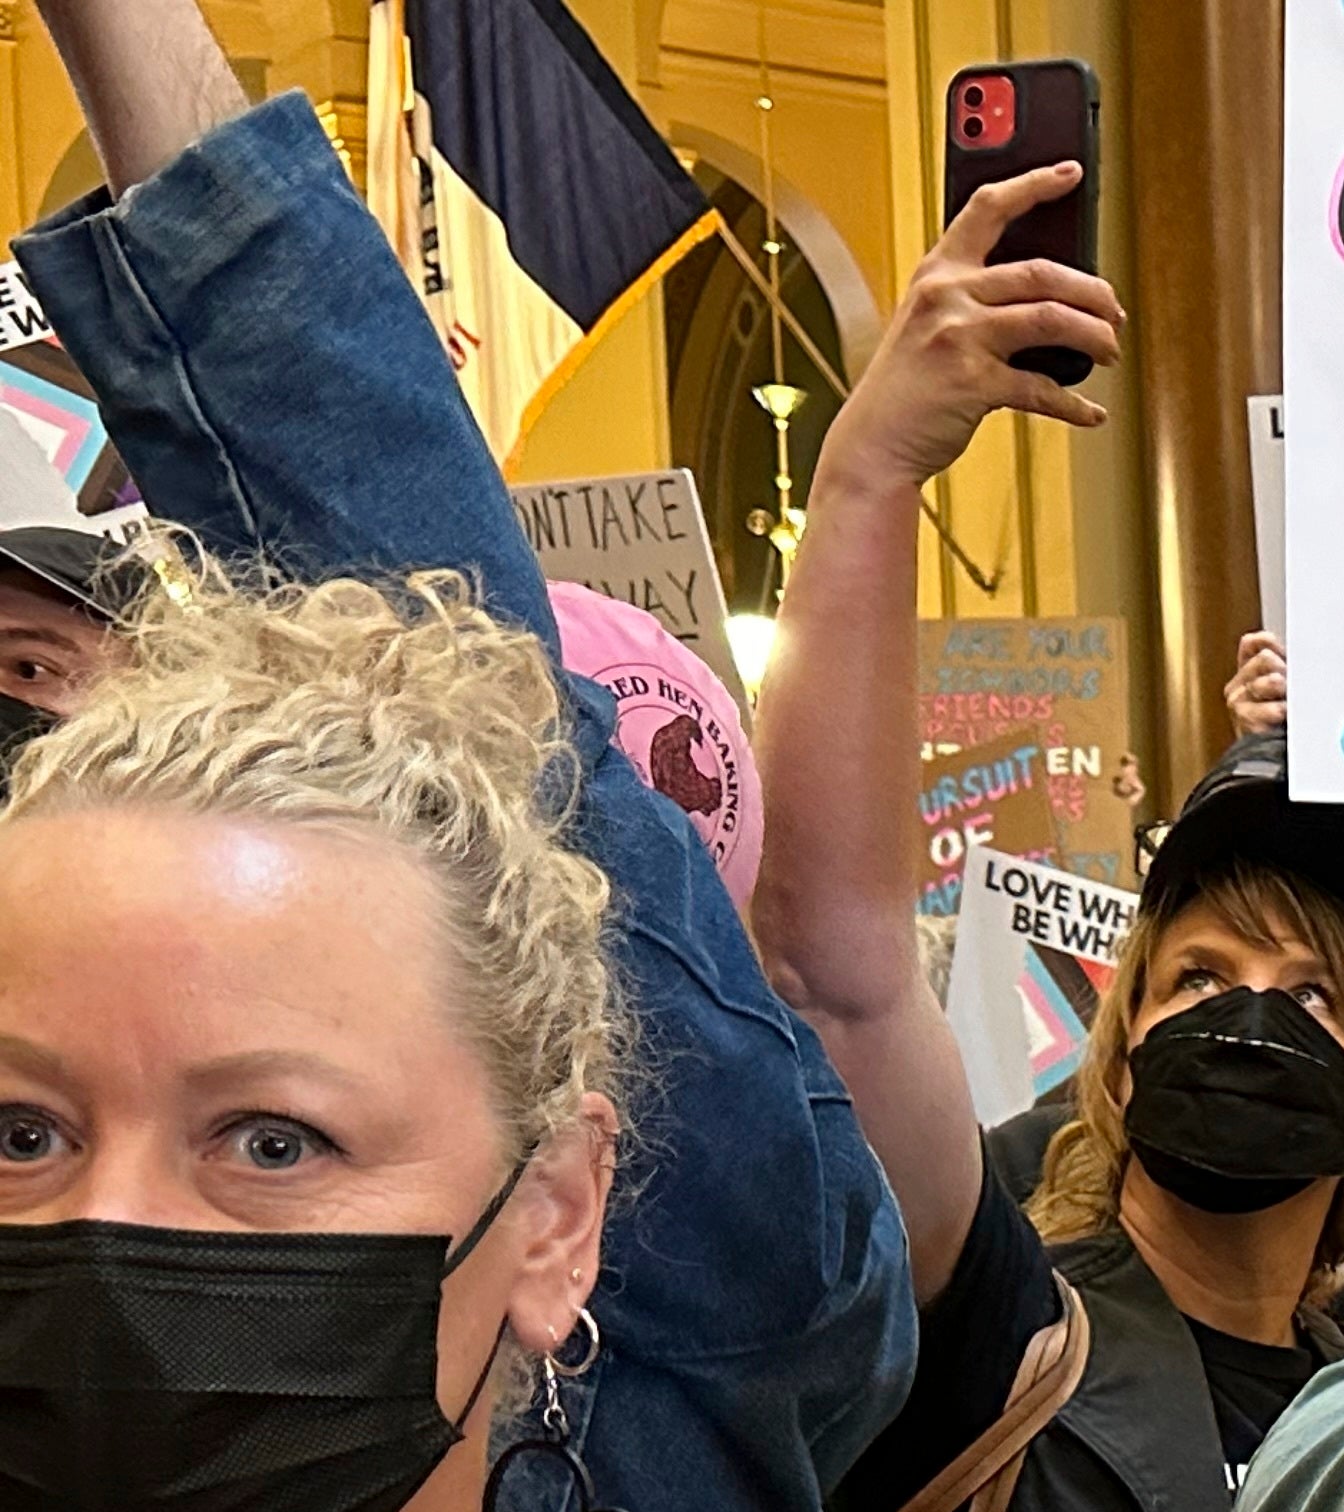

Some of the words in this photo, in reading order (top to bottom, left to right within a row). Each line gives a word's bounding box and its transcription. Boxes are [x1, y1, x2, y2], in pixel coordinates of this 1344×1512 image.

[576, 478, 686, 551] TAKE
[657, 676, 704, 721] HEN
[705, 719, 740, 834] BAKING
[918, 744, 1040, 825] URSUIT
[929, 811, 995, 867] OF
[984, 859, 1072, 913] LOVE
[1011, 902, 1052, 941] BE
